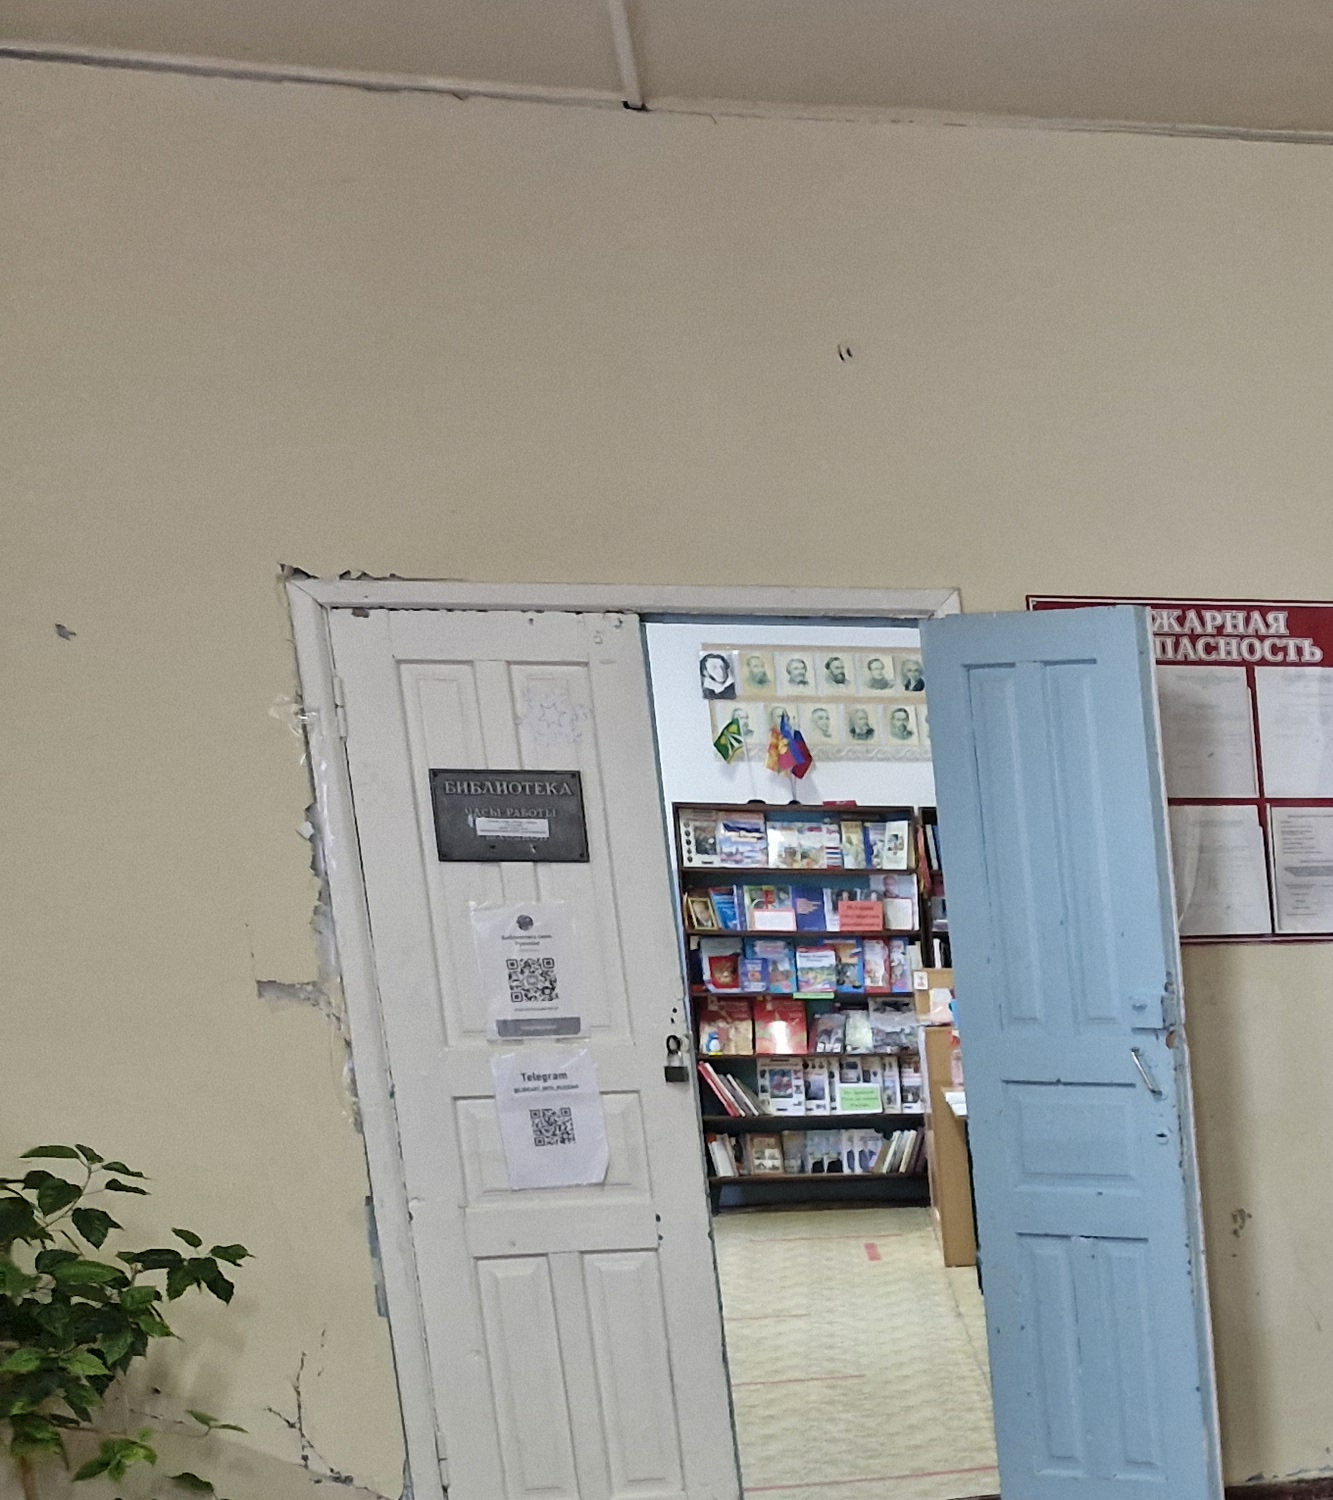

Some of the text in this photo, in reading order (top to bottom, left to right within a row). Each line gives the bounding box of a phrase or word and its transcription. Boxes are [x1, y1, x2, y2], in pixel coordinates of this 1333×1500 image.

[1152, 609, 1290, 635] ЖАРНАЯ
[1154, 635, 1324, 663] ПАСНОСТЬ
[444, 780, 574, 796] БИБЛИОТЕКА
[506, 808, 557, 818] РАБОТЫ
[521, 1071, 568, 1083] Telegram
